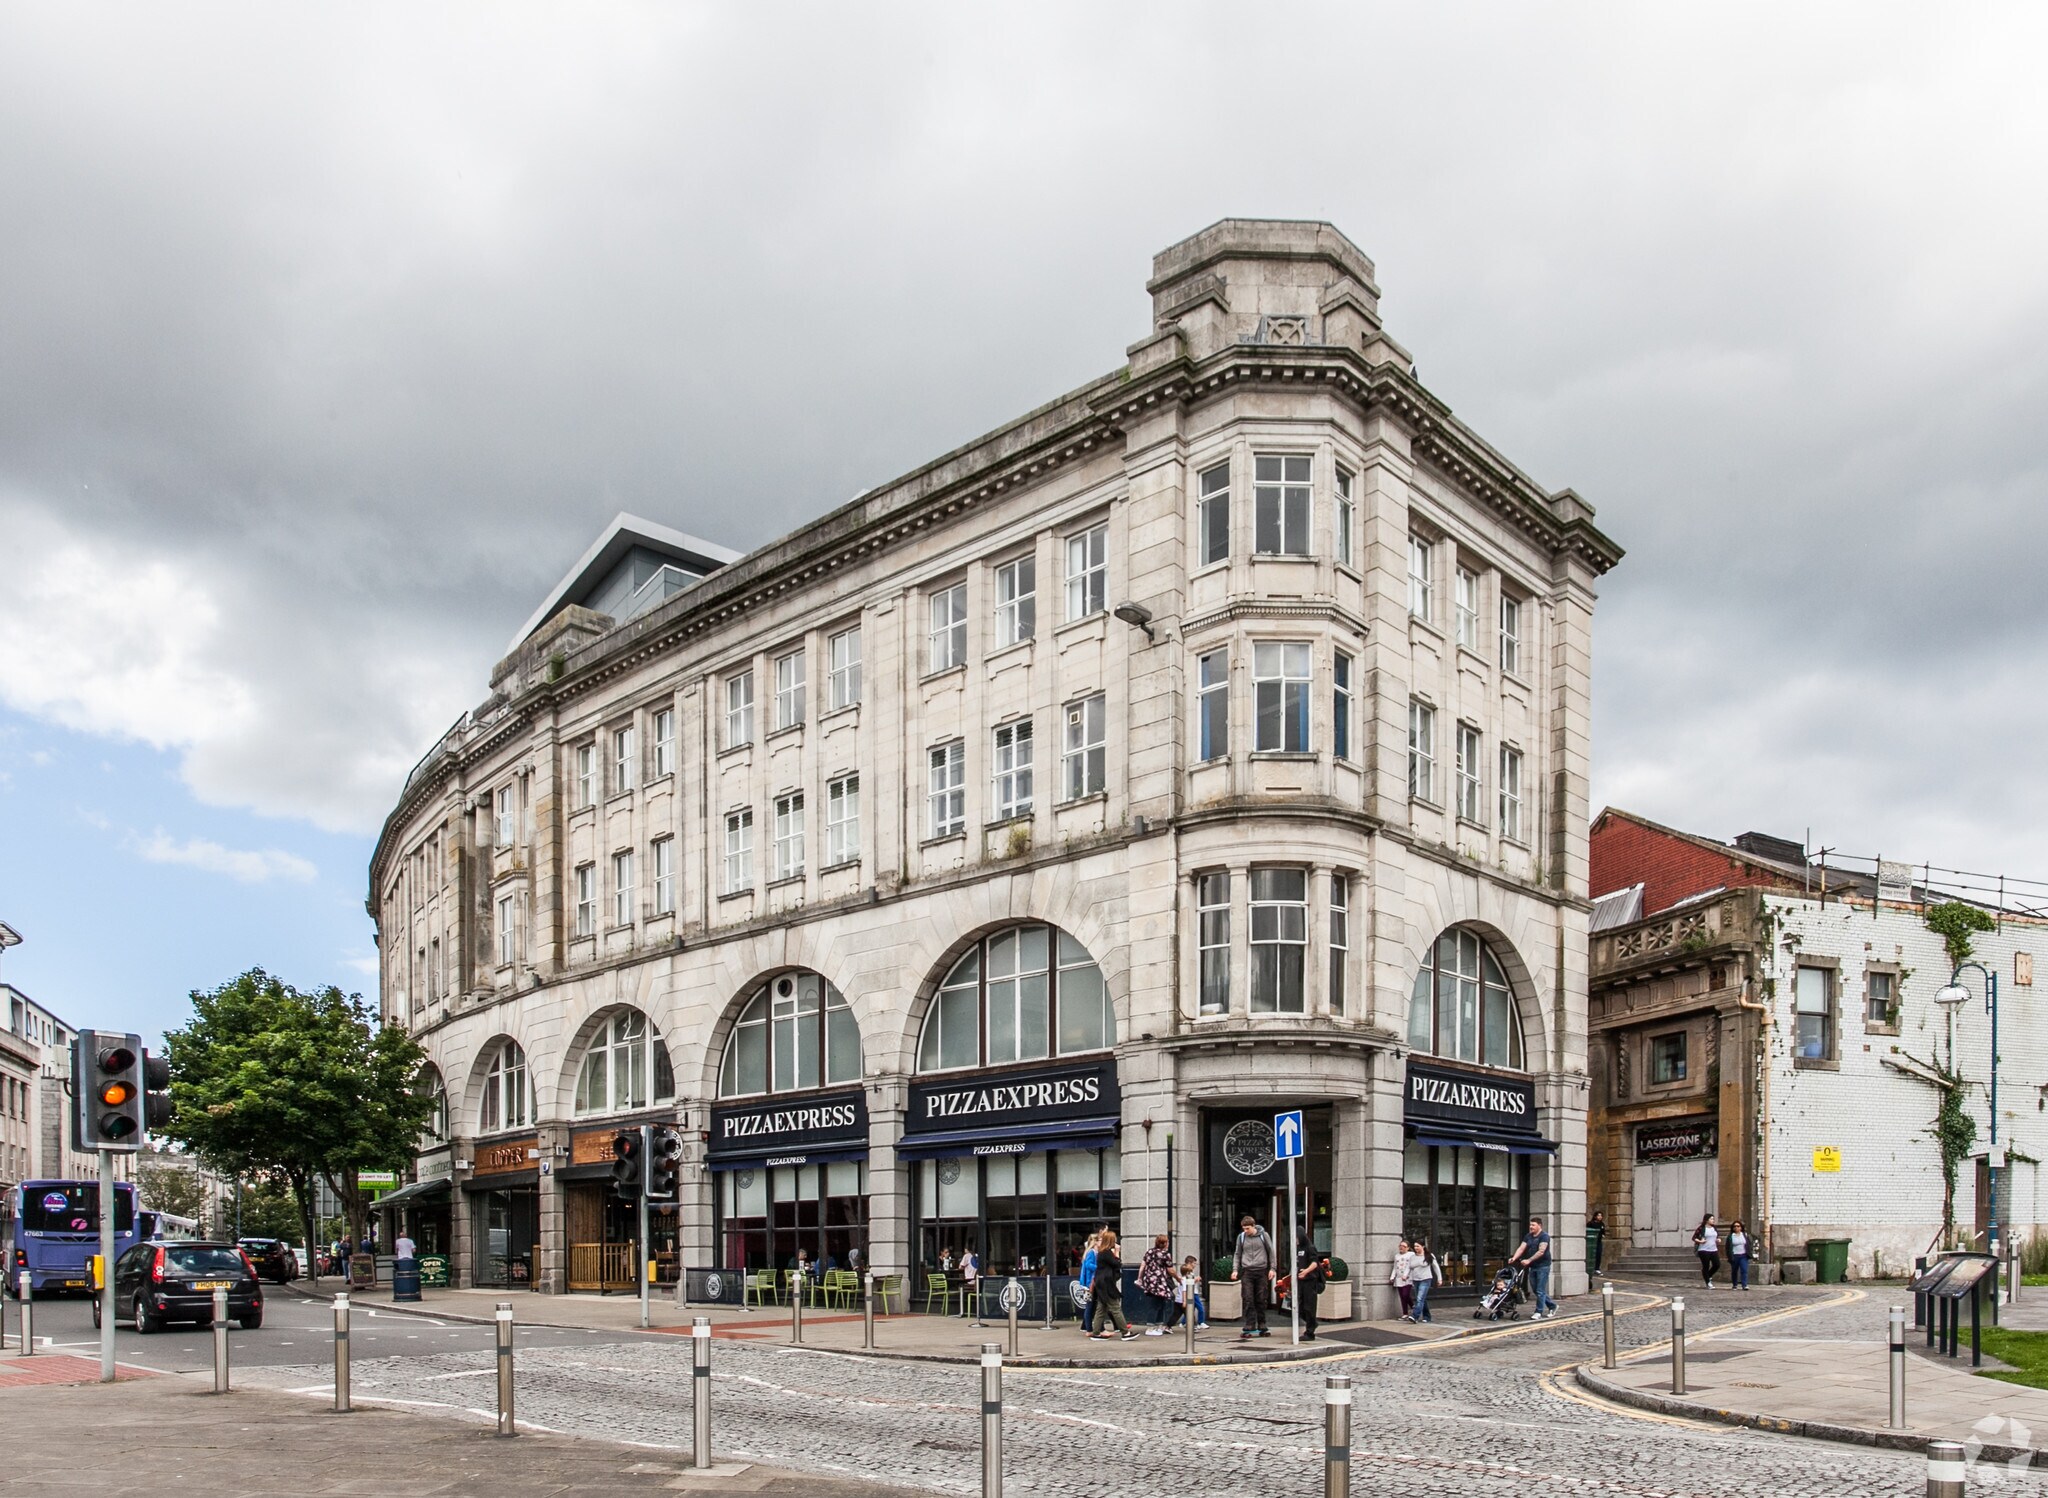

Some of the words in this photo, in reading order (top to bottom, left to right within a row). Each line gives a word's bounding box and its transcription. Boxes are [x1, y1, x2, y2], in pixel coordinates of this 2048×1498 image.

[926, 1077, 1100, 1118] PIZZAEXPRESS
[1411, 1076, 1526, 1115] PIZZAEXPRESS
[723, 1104, 856, 1138] PIZZAEXPRESS
[973, 1143, 1026, 1155] PIZZAEXPRESS
[1231, 1146, 1271, 1154] EXPRESS
[1640, 1134, 1700, 1151] LASERZONE
[766, 1156, 807, 1166] PIZZAEXPRESS
